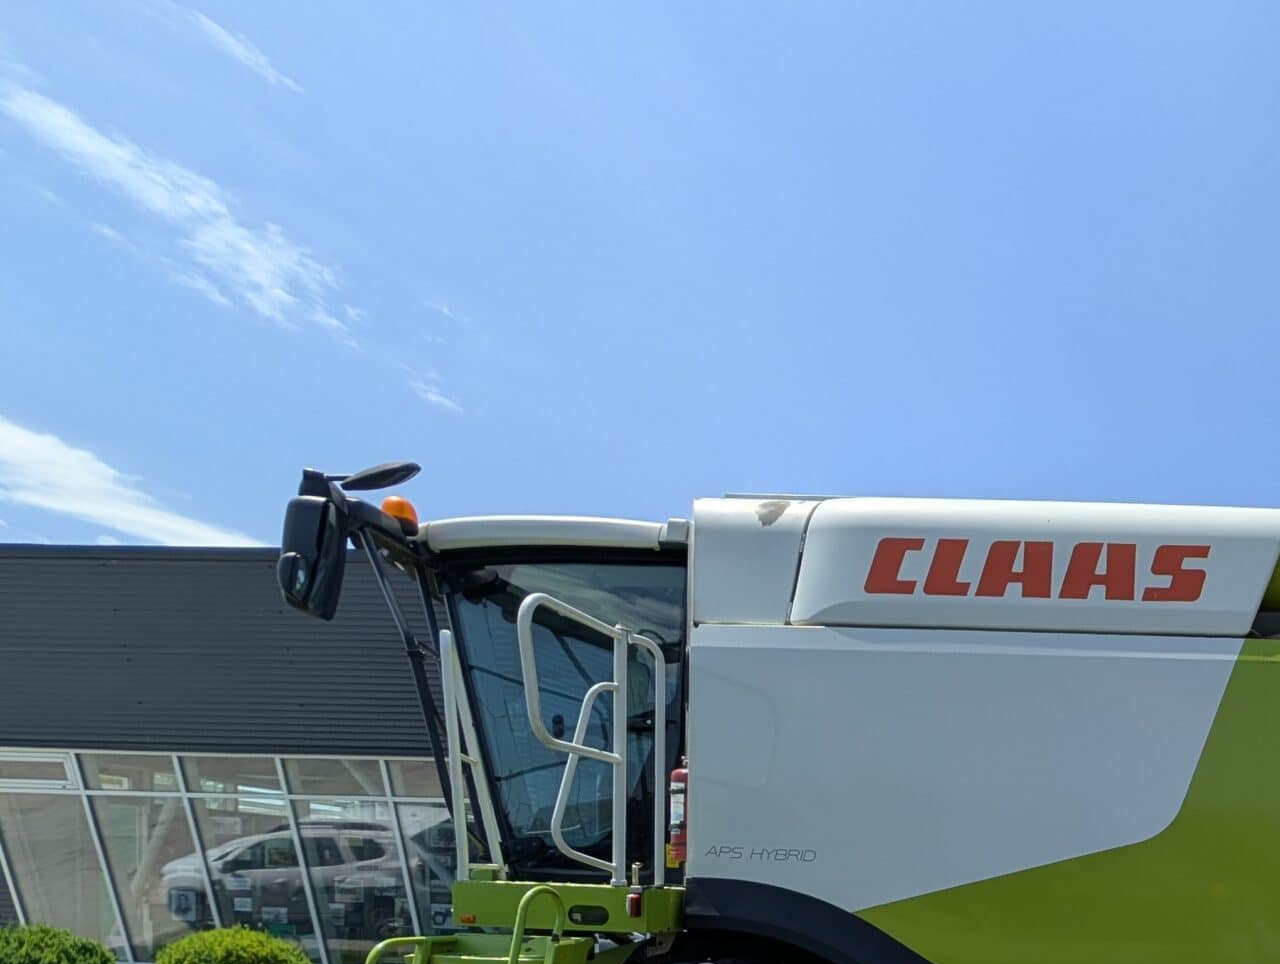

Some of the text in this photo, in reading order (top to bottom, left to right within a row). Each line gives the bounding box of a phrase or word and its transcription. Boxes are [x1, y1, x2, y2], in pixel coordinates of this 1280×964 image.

[864, 537, 1212, 602] CLAAS
[704, 845, 818, 863] APS HYBRID
